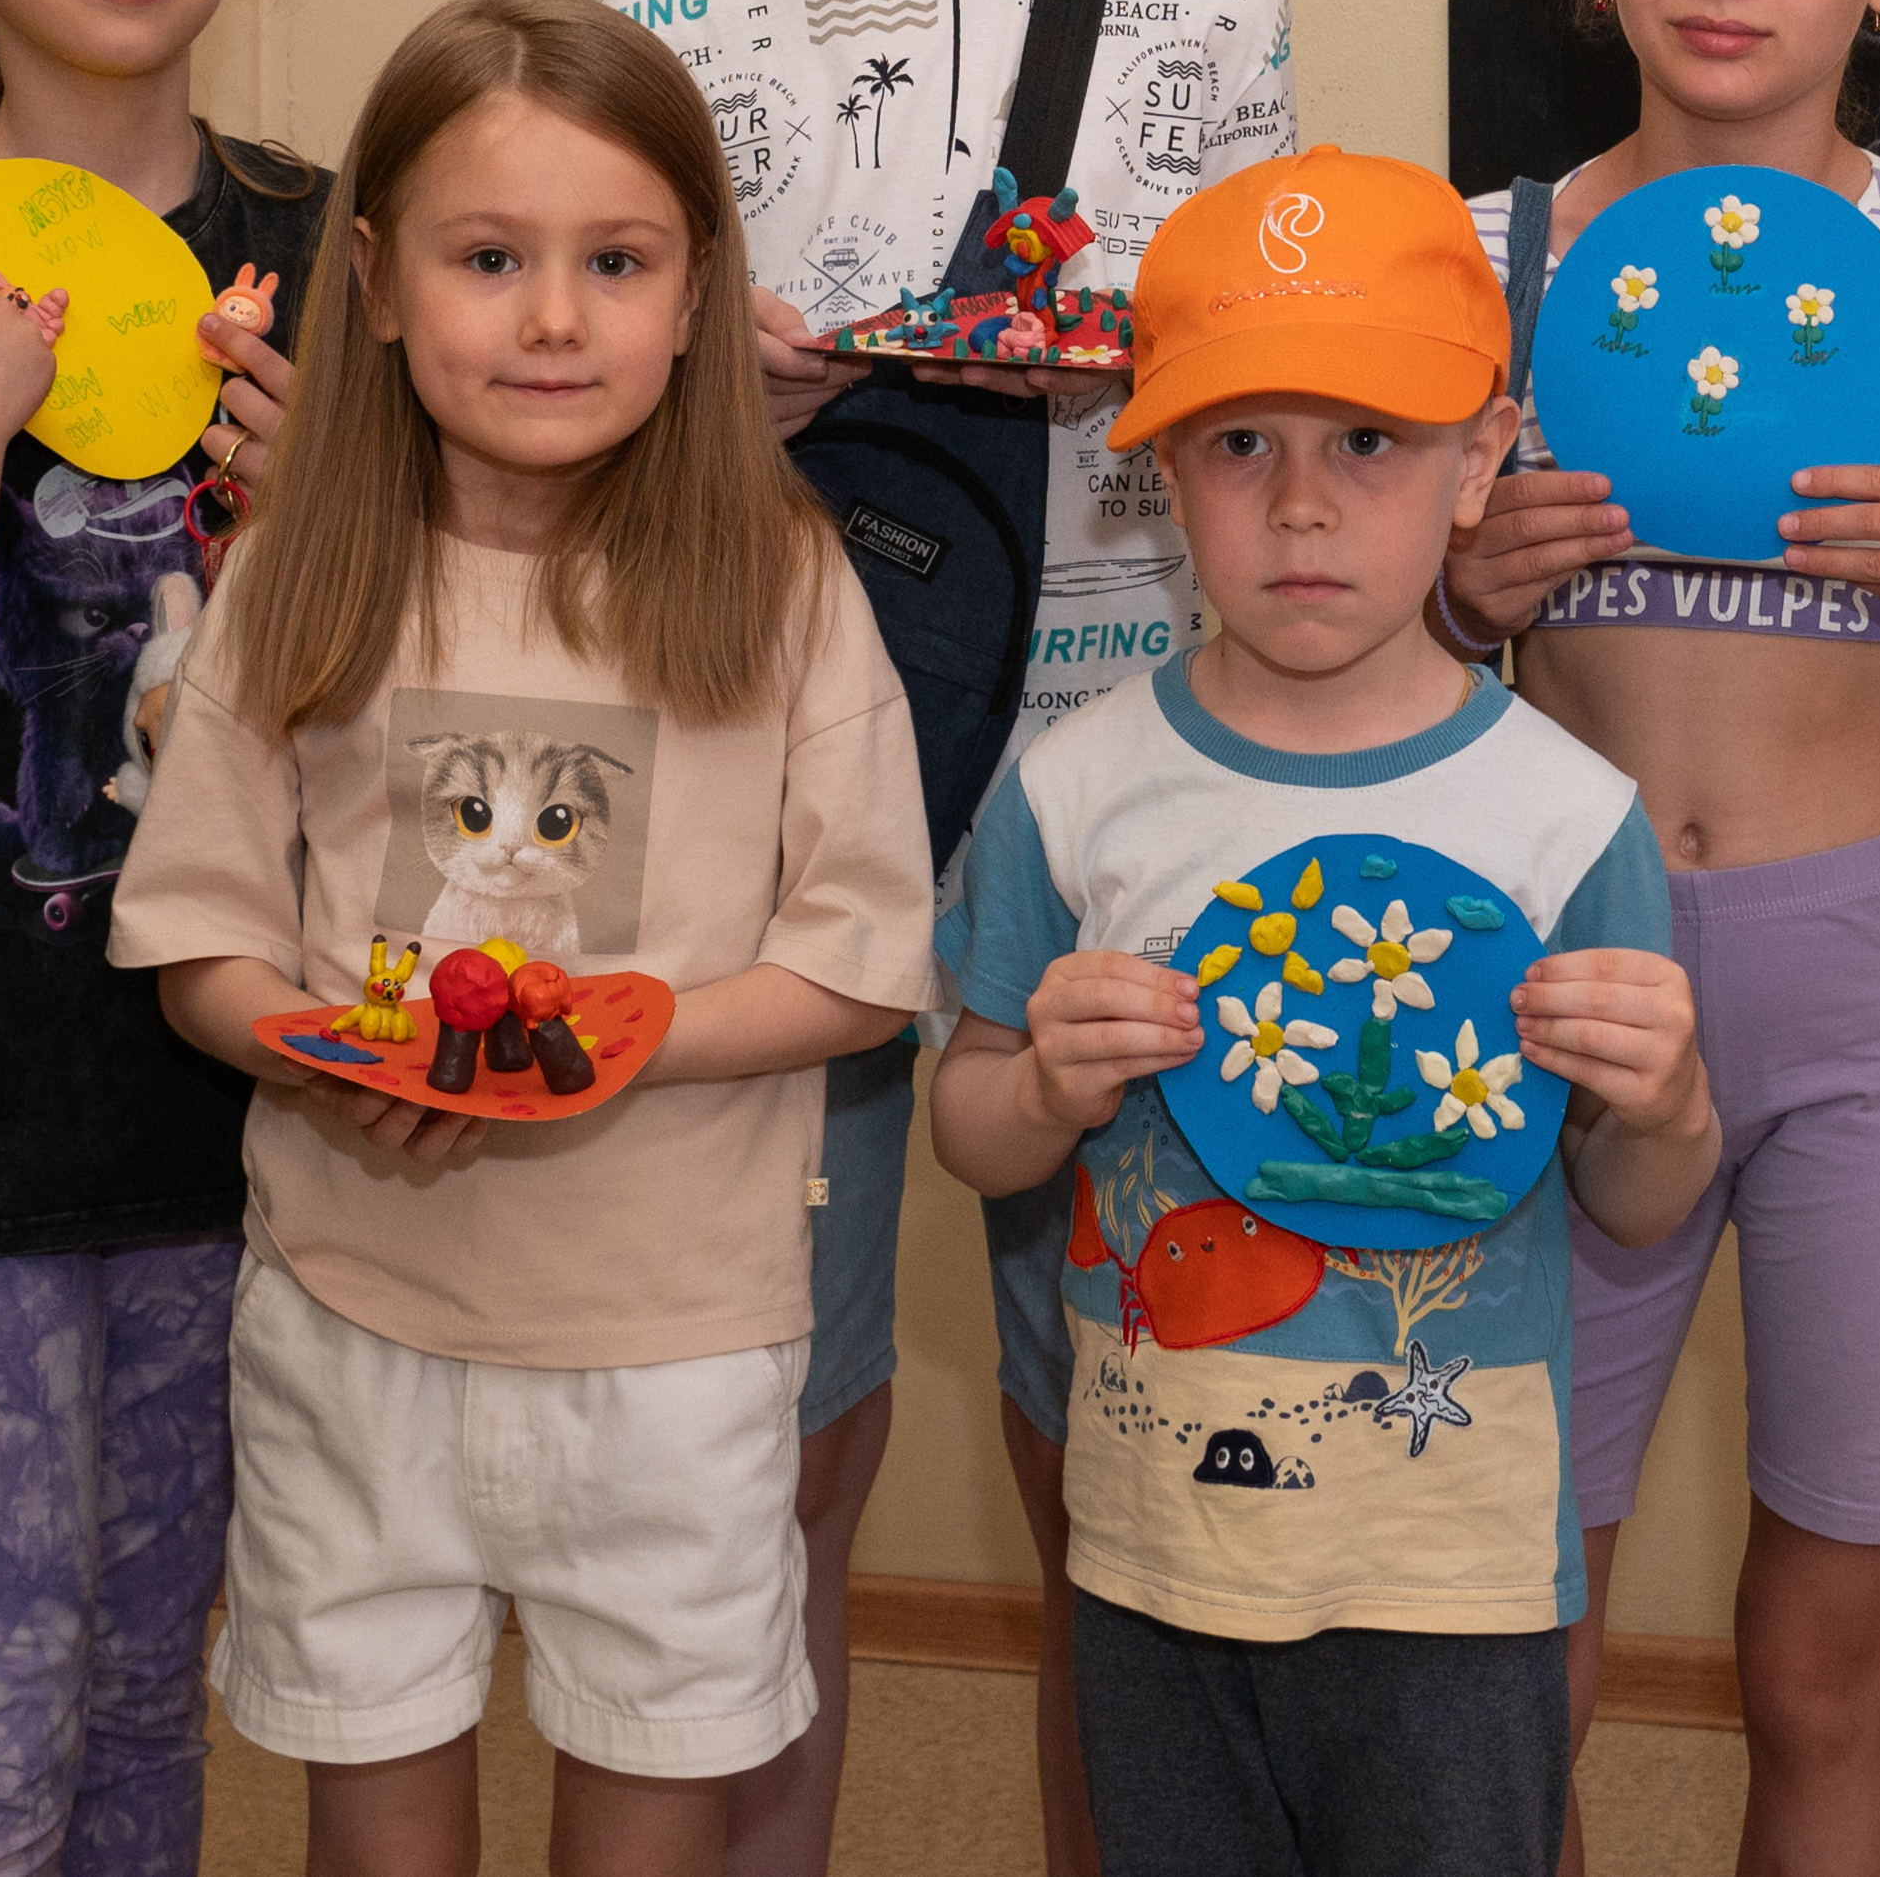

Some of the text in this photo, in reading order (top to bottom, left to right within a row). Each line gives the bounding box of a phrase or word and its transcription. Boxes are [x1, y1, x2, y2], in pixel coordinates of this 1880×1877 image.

[850, 215, 898, 246] CLUB
[858, 269, 916, 288] WAVE
[1085, 417, 1106, 439] YOU
[1078, 454, 1096, 465] BUT
[1088, 474, 1131, 493] CAN
[1098, 499, 1126, 518] TO
[858, 513, 931, 558] FASHION
[1672, 569, 1874, 633] VULPES
